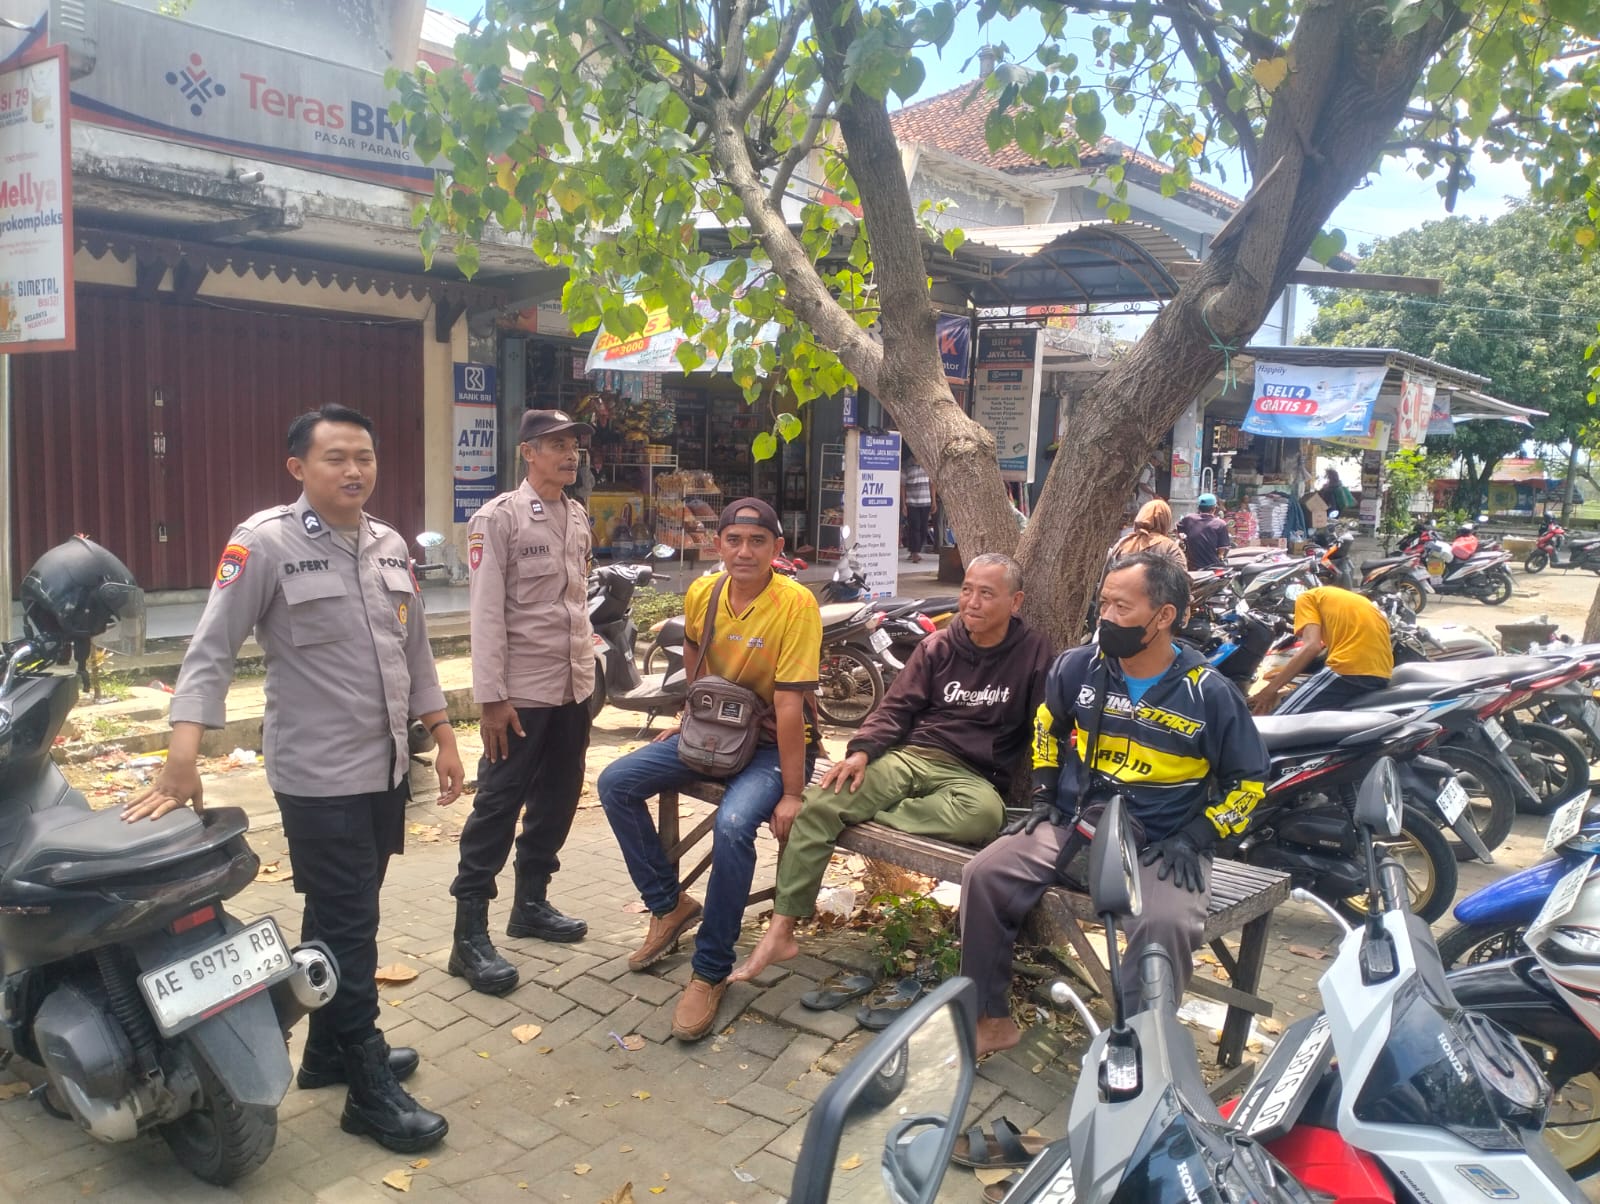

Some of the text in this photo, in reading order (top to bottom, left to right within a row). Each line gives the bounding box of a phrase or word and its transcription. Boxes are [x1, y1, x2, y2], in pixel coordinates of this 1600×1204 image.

[240, 73, 345, 130] Teras
[314, 130, 410, 161] PASAR PARANG
[0, 209, 63, 237] rokompleks
[1266, 385, 1306, 398] BELI 4
[1260, 399, 1313, 413] GRATIS 1
[475, 418, 494, 429] MINI
[457, 430, 494, 448] ATM
[861, 482, 884, 495] ATM
[522, 545, 550, 556] JURI
[284, 559, 329, 575] D.FERY
[1137, 706, 1202, 735] START
[153, 927, 276, 1000] AE 6975 RB
[1437, 1032, 1469, 1083] HONDA
[1176, 1160, 1203, 1204] HON
